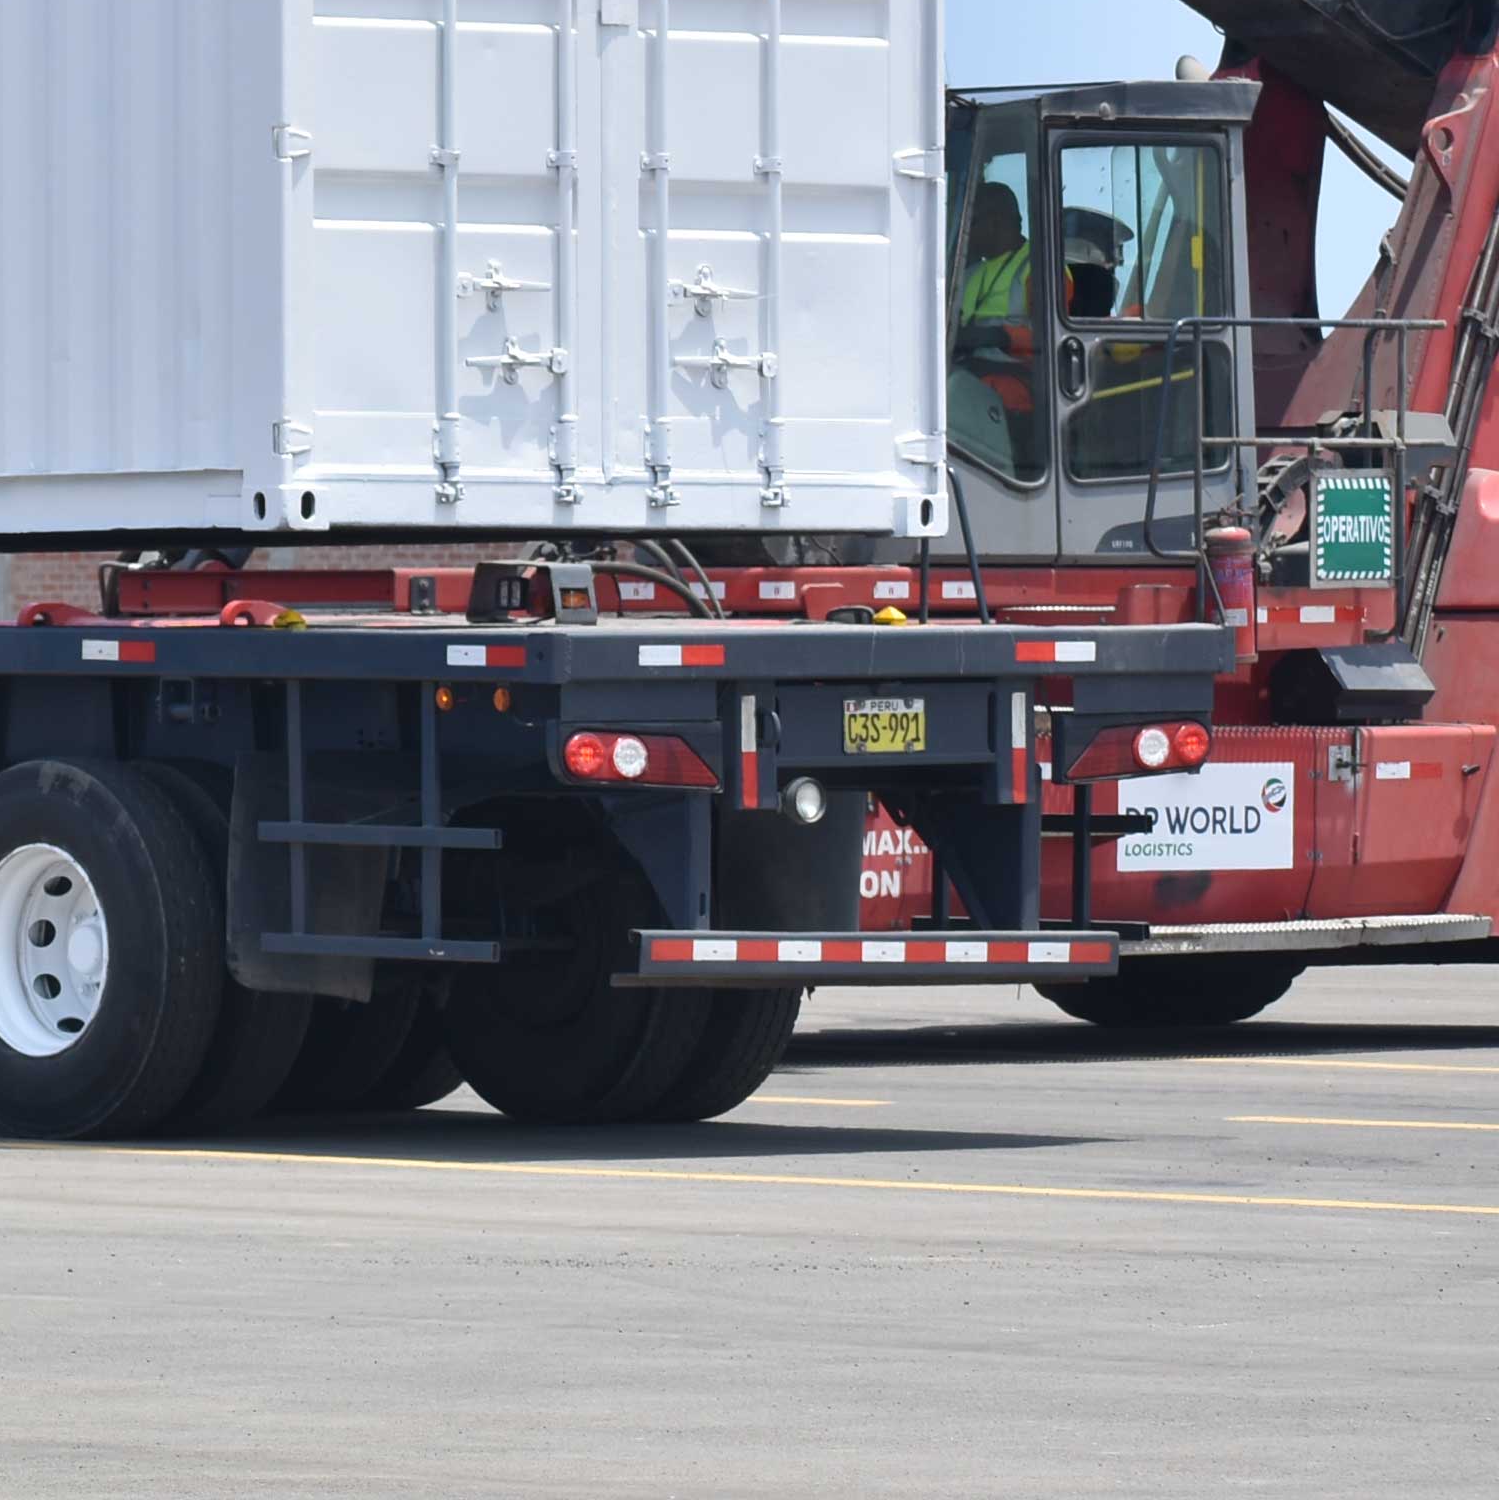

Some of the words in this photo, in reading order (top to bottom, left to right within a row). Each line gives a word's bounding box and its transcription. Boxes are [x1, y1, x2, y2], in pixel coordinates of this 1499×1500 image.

[1323, 515, 1385, 543] OPERATIVO
[870, 700, 899, 712] PERU
[847, 712, 921, 744] C3S-991
[1165, 805, 1261, 835] WORLD
[1124, 842, 1193, 857] LOGISTICS
